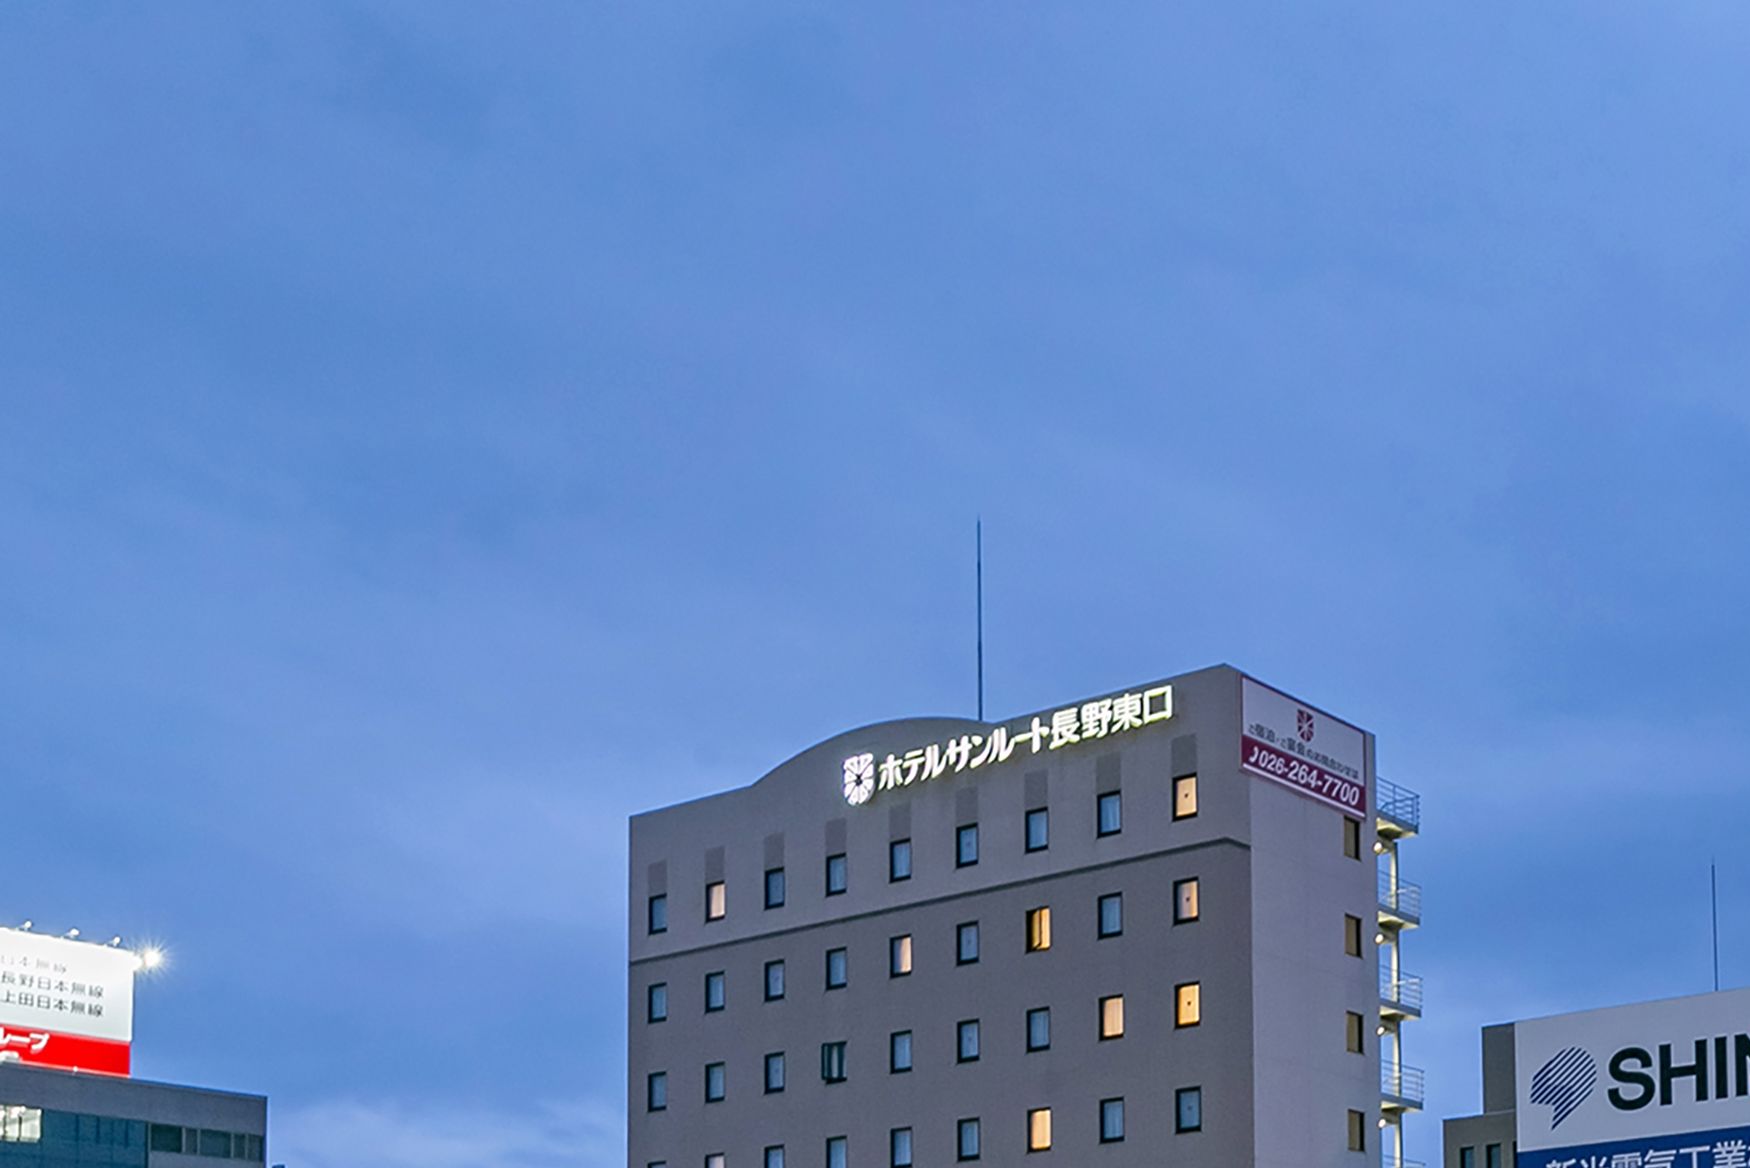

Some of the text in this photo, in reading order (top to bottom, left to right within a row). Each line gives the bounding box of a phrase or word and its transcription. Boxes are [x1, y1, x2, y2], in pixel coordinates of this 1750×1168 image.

[878, 685, 1173, 791] ホテルサンルート長野東口
[1258, 750, 1360, 806] 026-264-7700
[1, 970, 104, 999] 長野日本無線
[4, 989, 104, 1017] 上田日本無線
